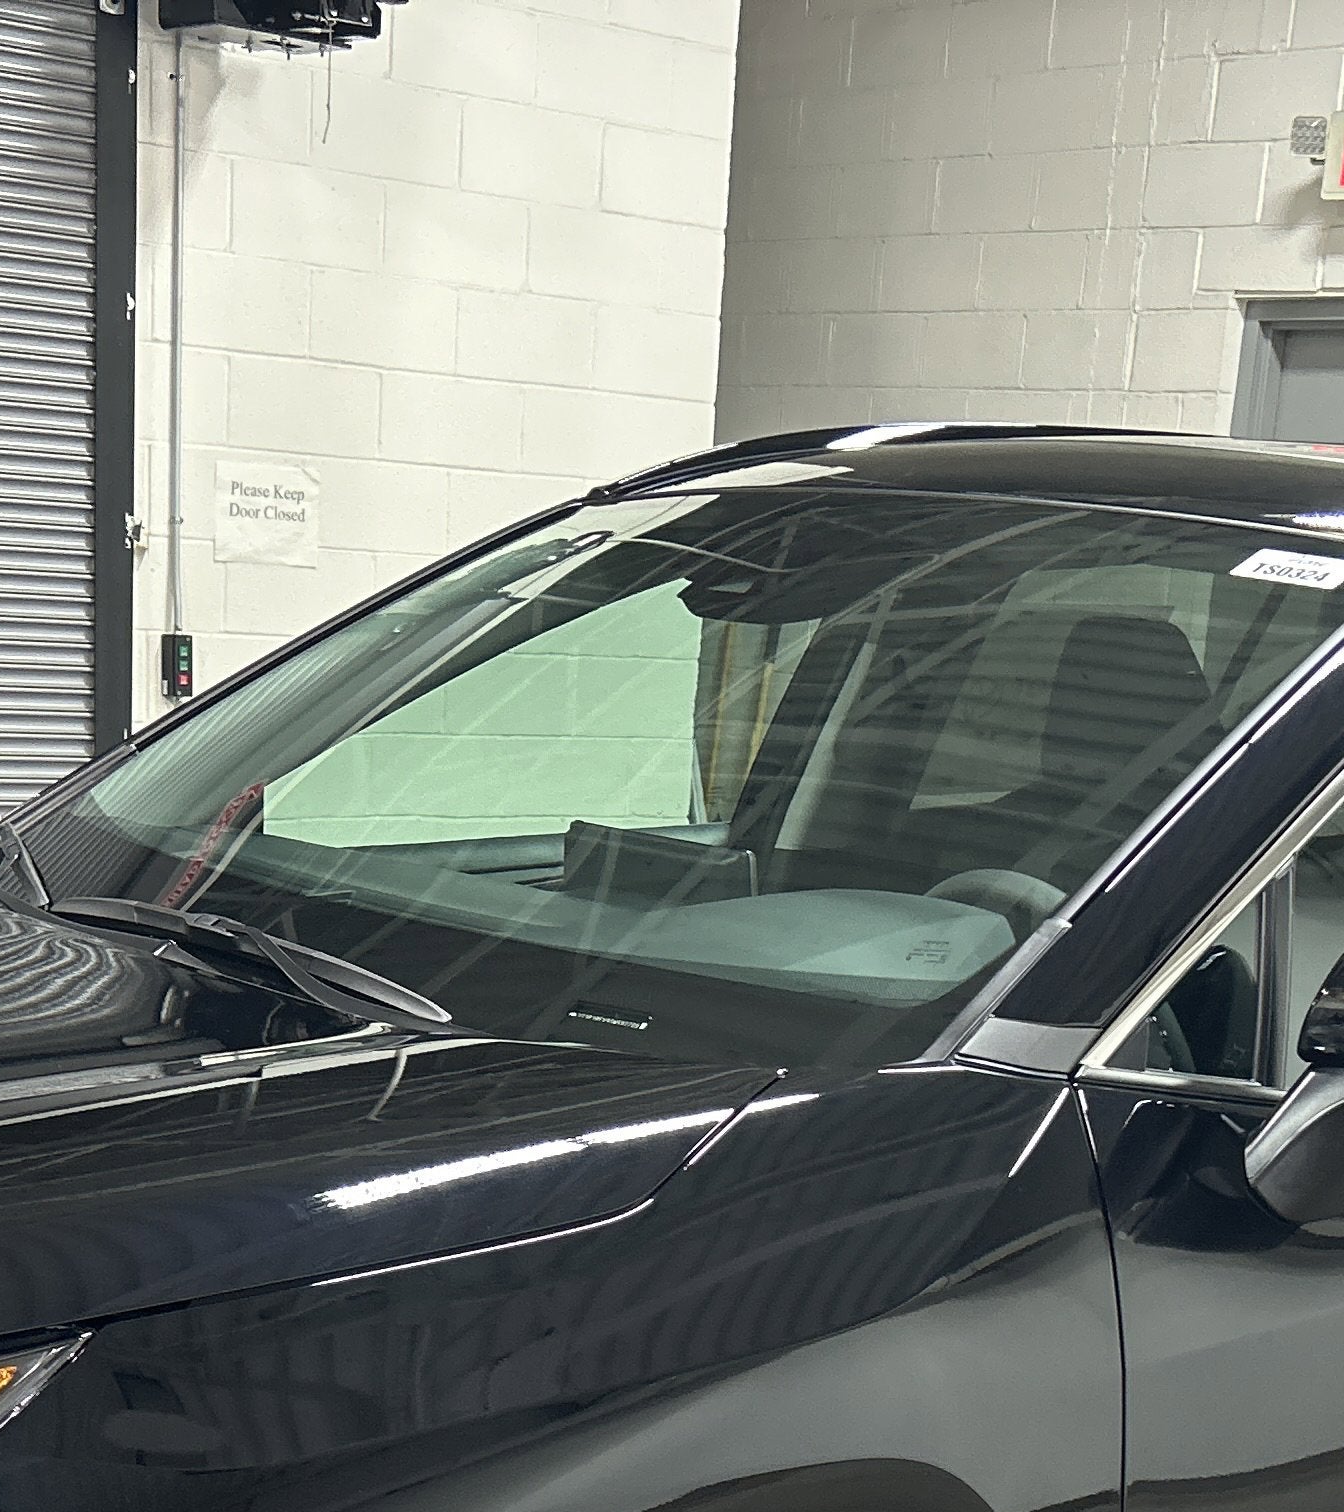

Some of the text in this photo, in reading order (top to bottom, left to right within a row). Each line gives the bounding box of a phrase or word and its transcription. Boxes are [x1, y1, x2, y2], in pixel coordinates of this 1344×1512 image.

[230, 480, 305, 505] Please Keep
[229, 502, 306, 523] Door Closed
